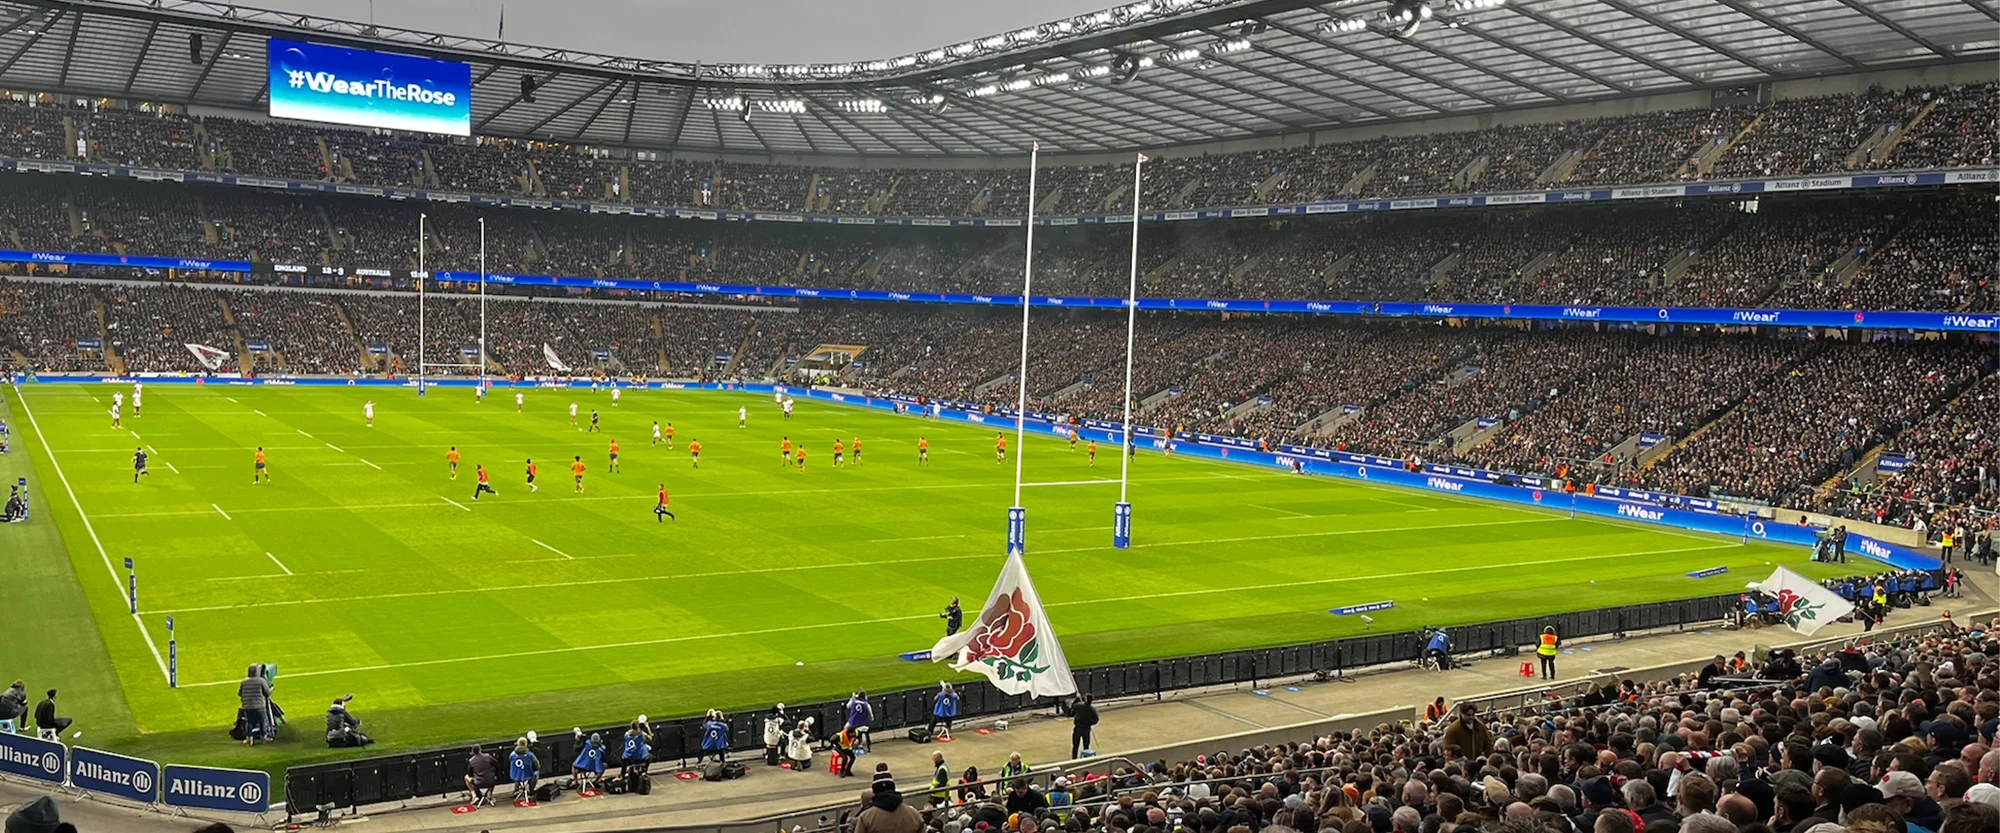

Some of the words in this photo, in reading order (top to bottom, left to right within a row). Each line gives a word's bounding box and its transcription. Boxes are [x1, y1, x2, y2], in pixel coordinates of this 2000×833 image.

[288, 69, 456, 106] #WearTheRose
[1877, 176, 1905, 184] Allianz
[1957, 172, 1986, 180] Allianz
[1708, 185, 1732, 193] Allianz
[1775, 181, 1799, 189] Allianz
[1812, 178, 1842, 188] Stadium
[1306, 302, 1332, 310] #Wear
[1424, 304, 1452, 313] #Wear
[1562, 307, 1600, 318] #WearT
[1733, 311, 1780, 322] #WearT
[1943, 315, 2000, 328] #WearT
[1428, 477, 1463, 490] #Wear
[1618, 504, 1664, 521] #Wear
[1752, 522, 1766, 538] O2
[1860, 538, 1891, 559] #Wear
[0, 744, 40, 766] llianz
[76, 760, 130, 785] Allianz
[170, 778, 236, 798] Allianz
